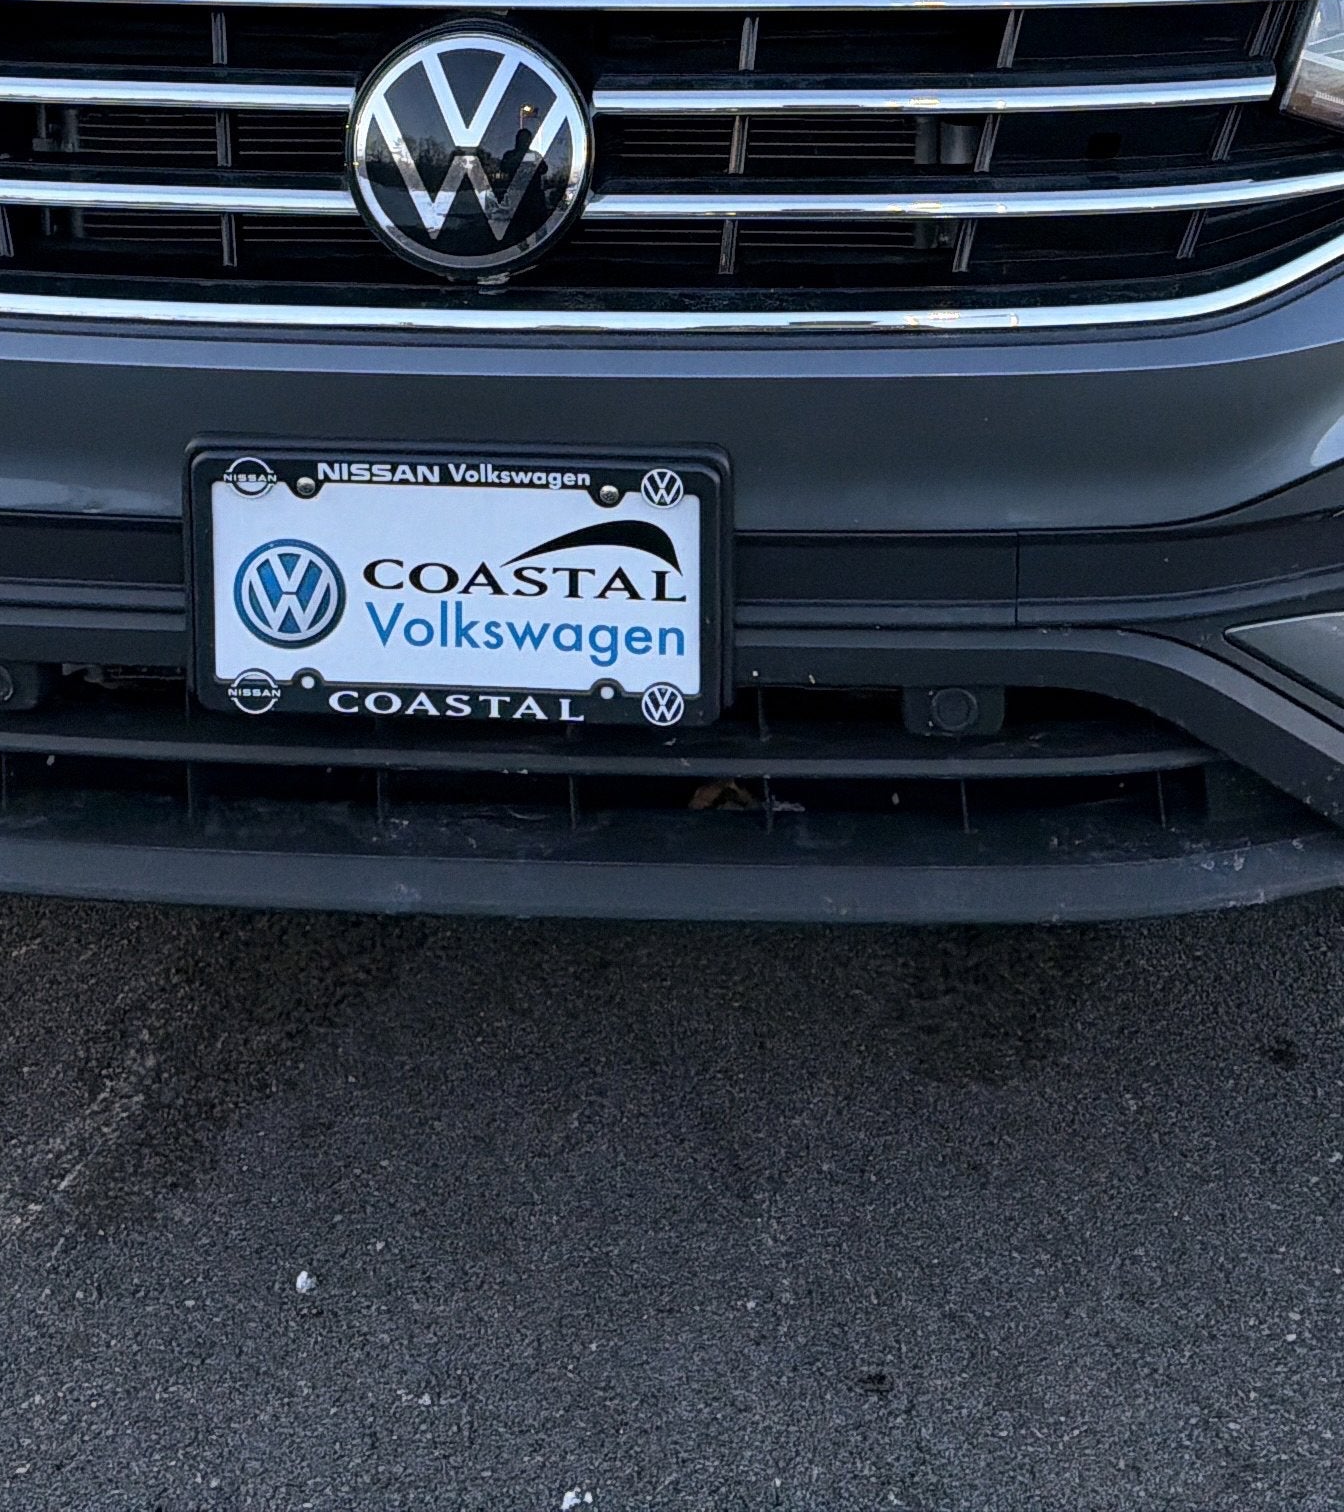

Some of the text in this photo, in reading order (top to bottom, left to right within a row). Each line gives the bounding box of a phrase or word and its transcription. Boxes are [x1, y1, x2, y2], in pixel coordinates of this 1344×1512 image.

[223, 473, 277, 483] NISSAN
[316, 462, 591, 489] NISSAN Volkswagen
[362, 558, 687, 603] COASTAL
[365, 600, 686, 666] Volkswagen
[227, 688, 281, 698] NISSAN
[328, 690, 585, 723] COASTAL
